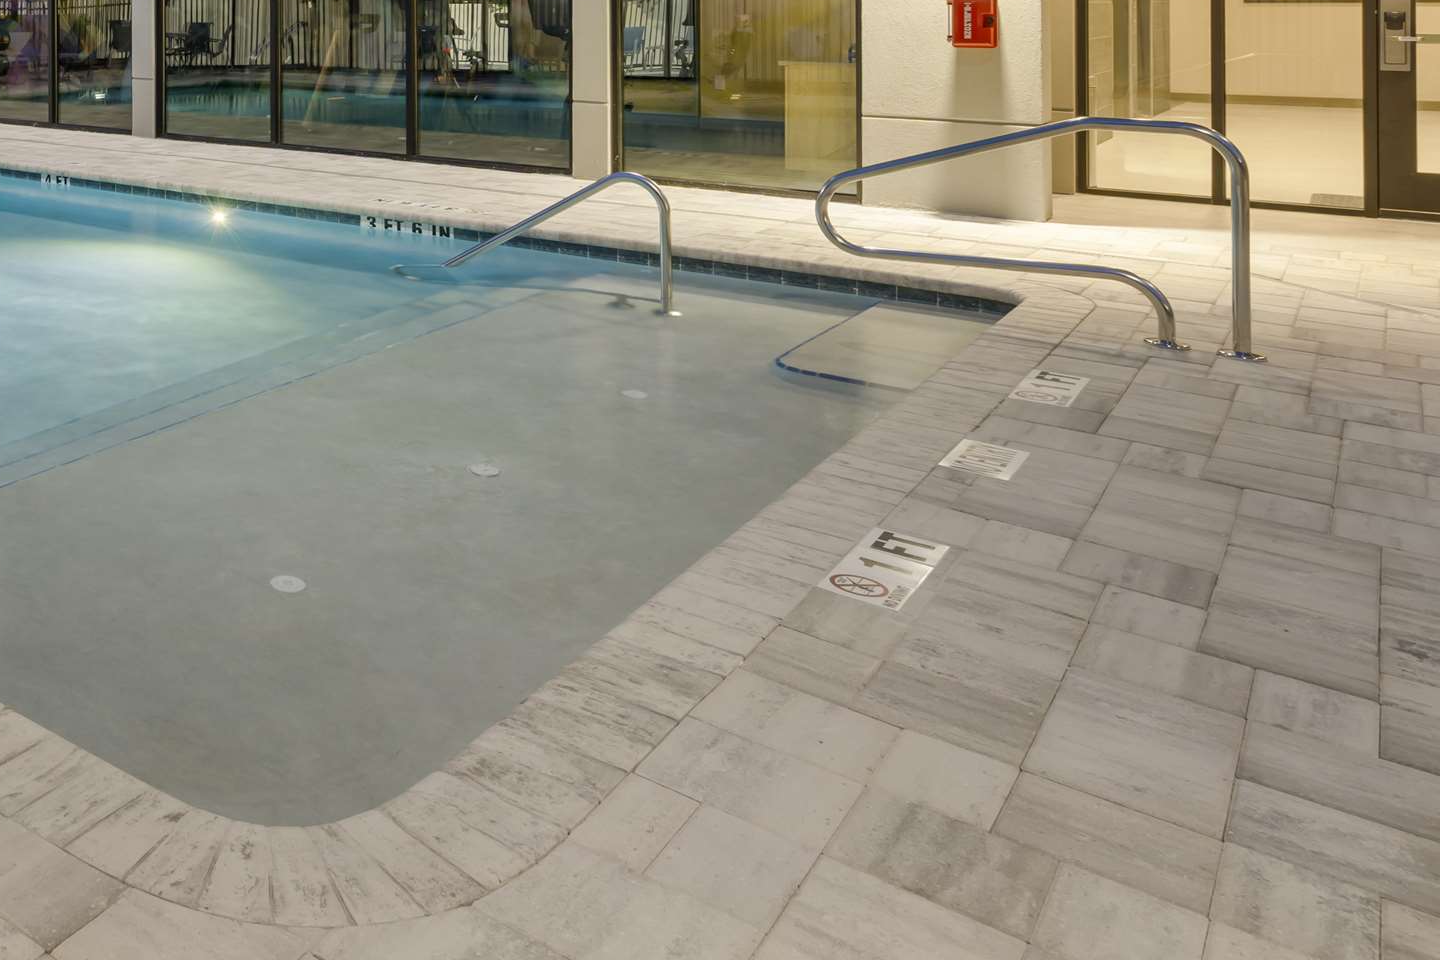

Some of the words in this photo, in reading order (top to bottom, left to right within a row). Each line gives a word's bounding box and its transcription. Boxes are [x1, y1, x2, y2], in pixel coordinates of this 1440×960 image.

[366, 216, 376, 228] 3
[384, 219, 402, 231] FT
[432, 224, 450, 238] IN
[1035, 371, 1081, 385] FT
[871, 531, 936, 562] FT
[859, 556, 914, 575] 1
